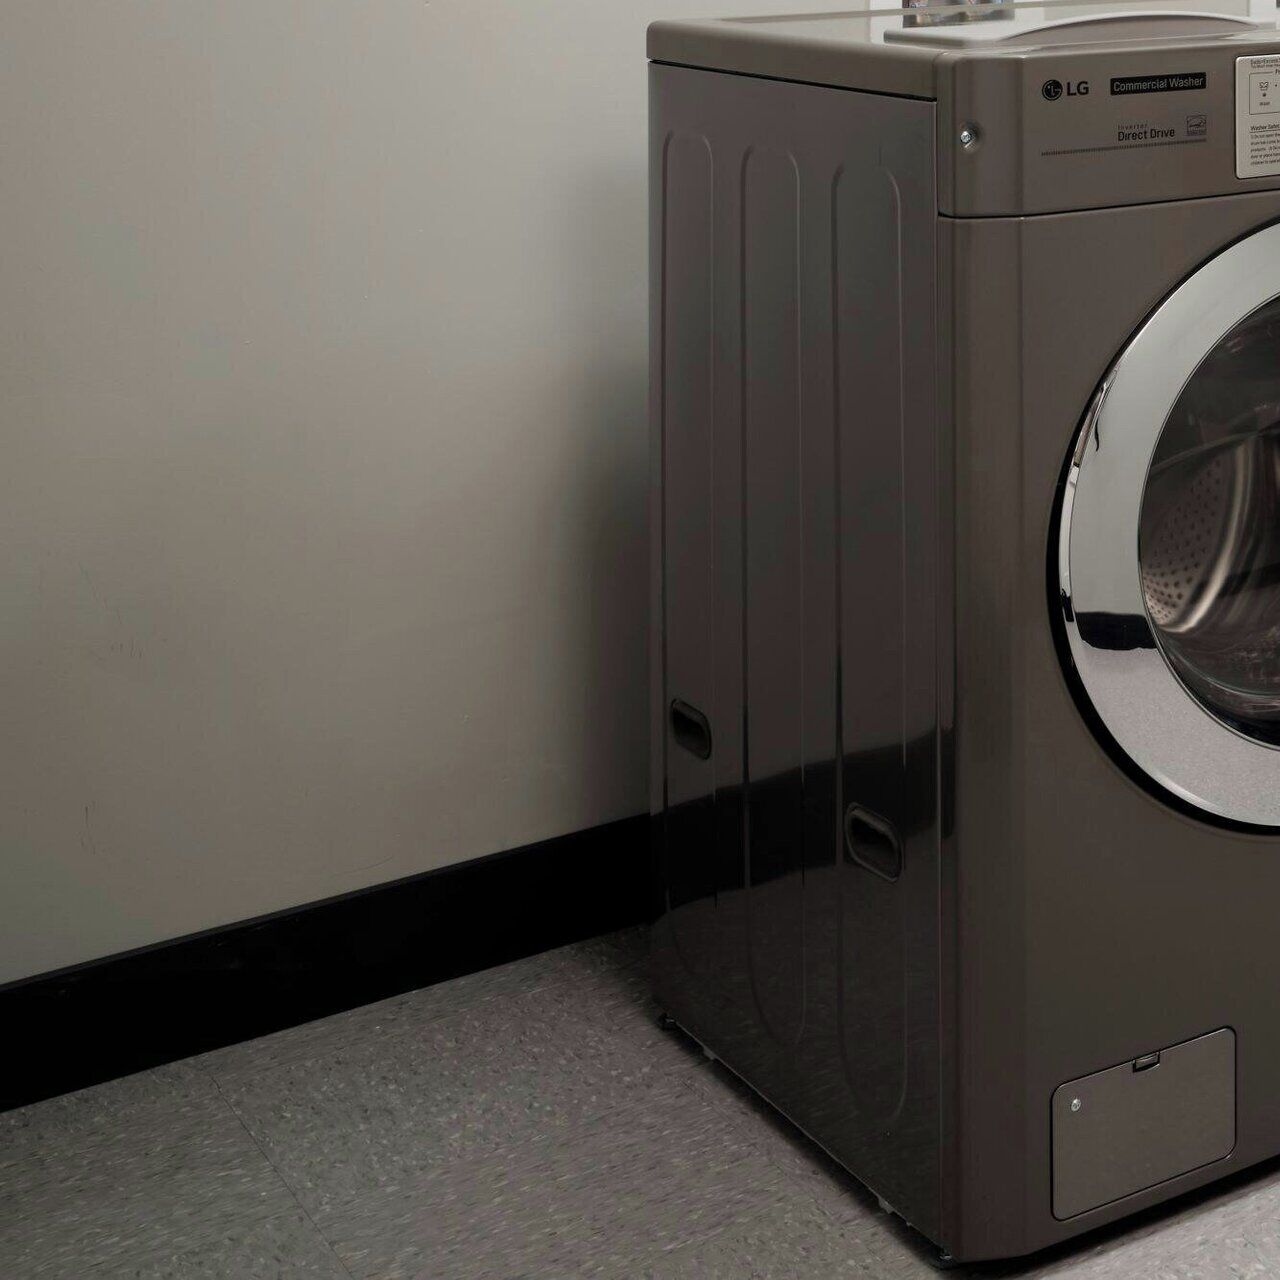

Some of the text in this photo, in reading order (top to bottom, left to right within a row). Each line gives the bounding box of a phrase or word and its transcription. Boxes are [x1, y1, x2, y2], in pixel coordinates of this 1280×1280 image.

[1067, 81, 1089, 96] LG
[1113, 77, 1203, 93] Commercial Washer
[1118, 127, 1175, 142] Direct Drive
